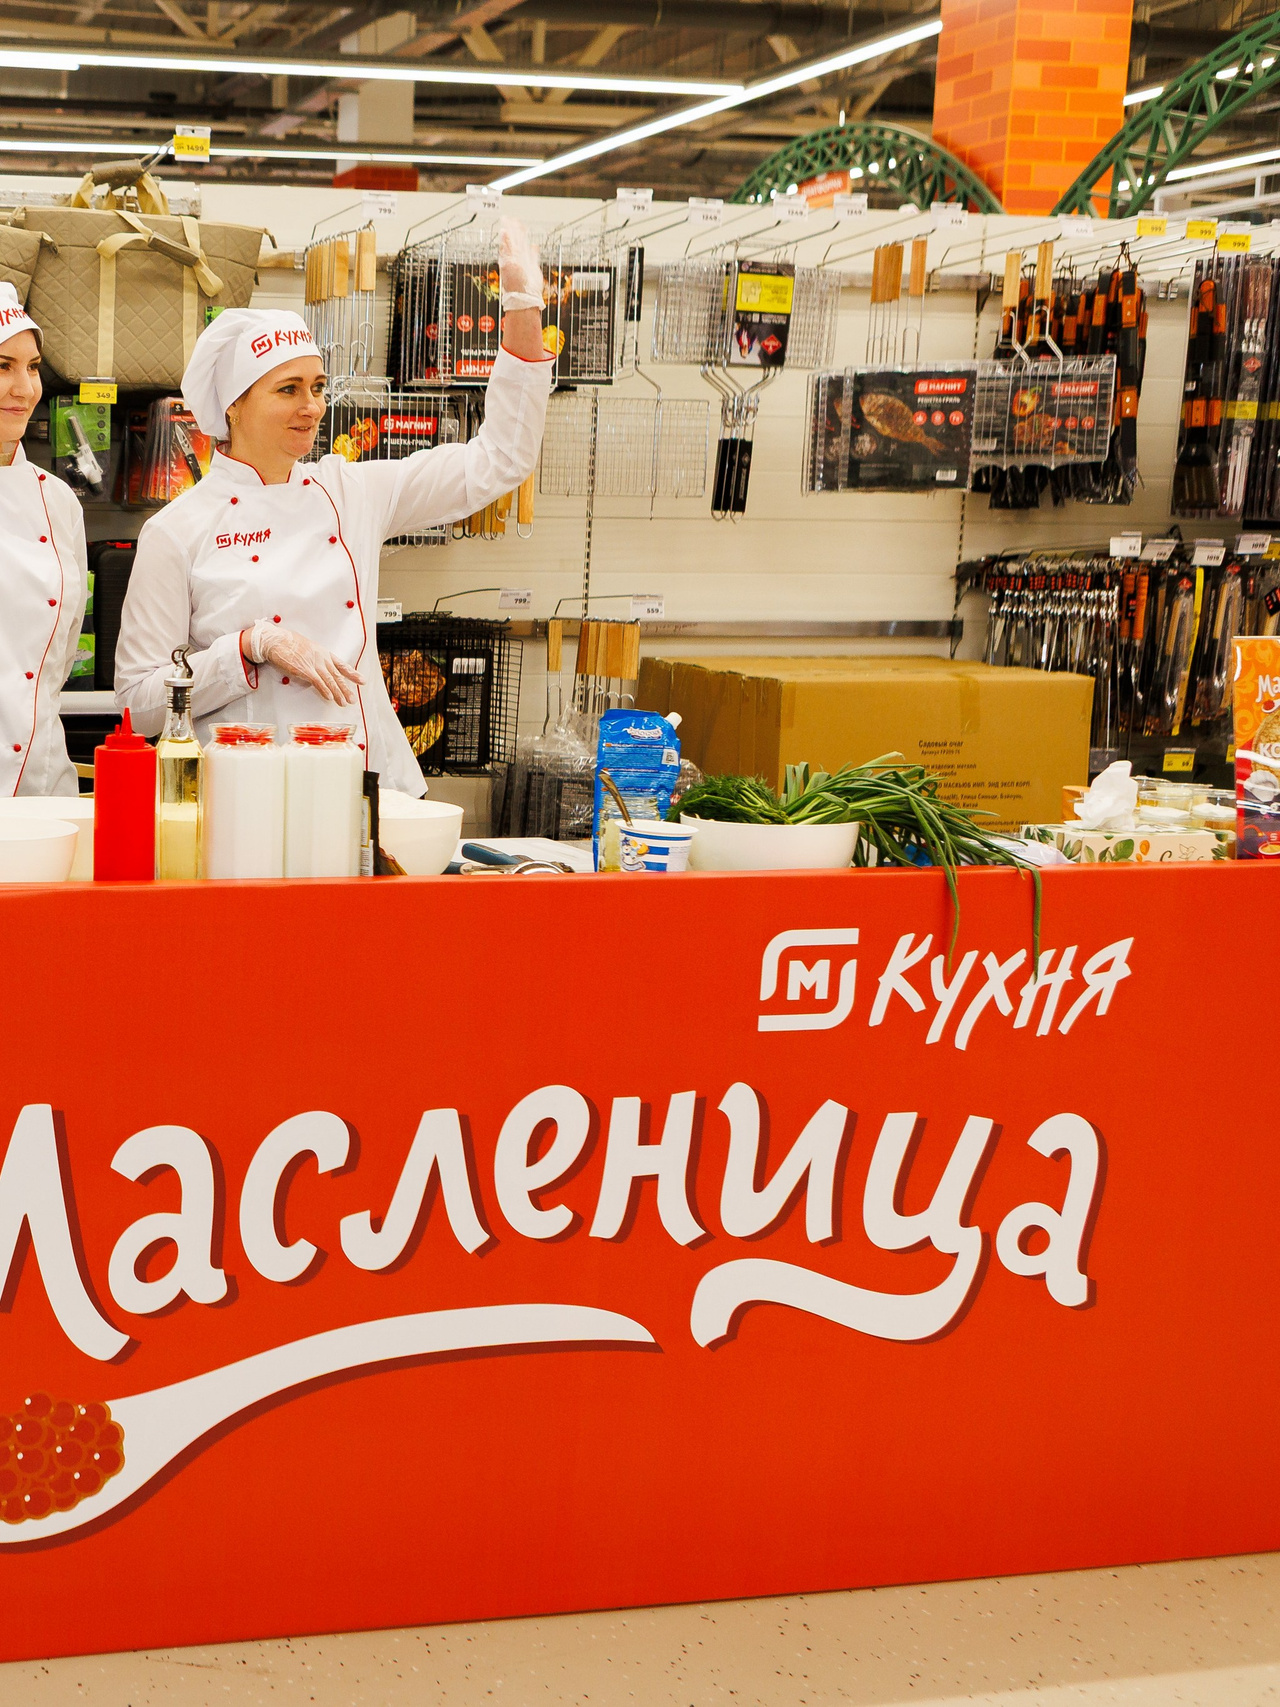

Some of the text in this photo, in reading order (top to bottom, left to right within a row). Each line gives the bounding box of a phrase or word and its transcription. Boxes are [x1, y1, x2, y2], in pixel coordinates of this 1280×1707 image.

[928, 382, 963, 391] МАГНИТ
[395, 420, 433, 431] МАГНИТ
[233, 528, 271, 548] КУХНЯ
[918, 740, 947, 748] Садовый
[868, 932, 1135, 1051] КУХНЯ
